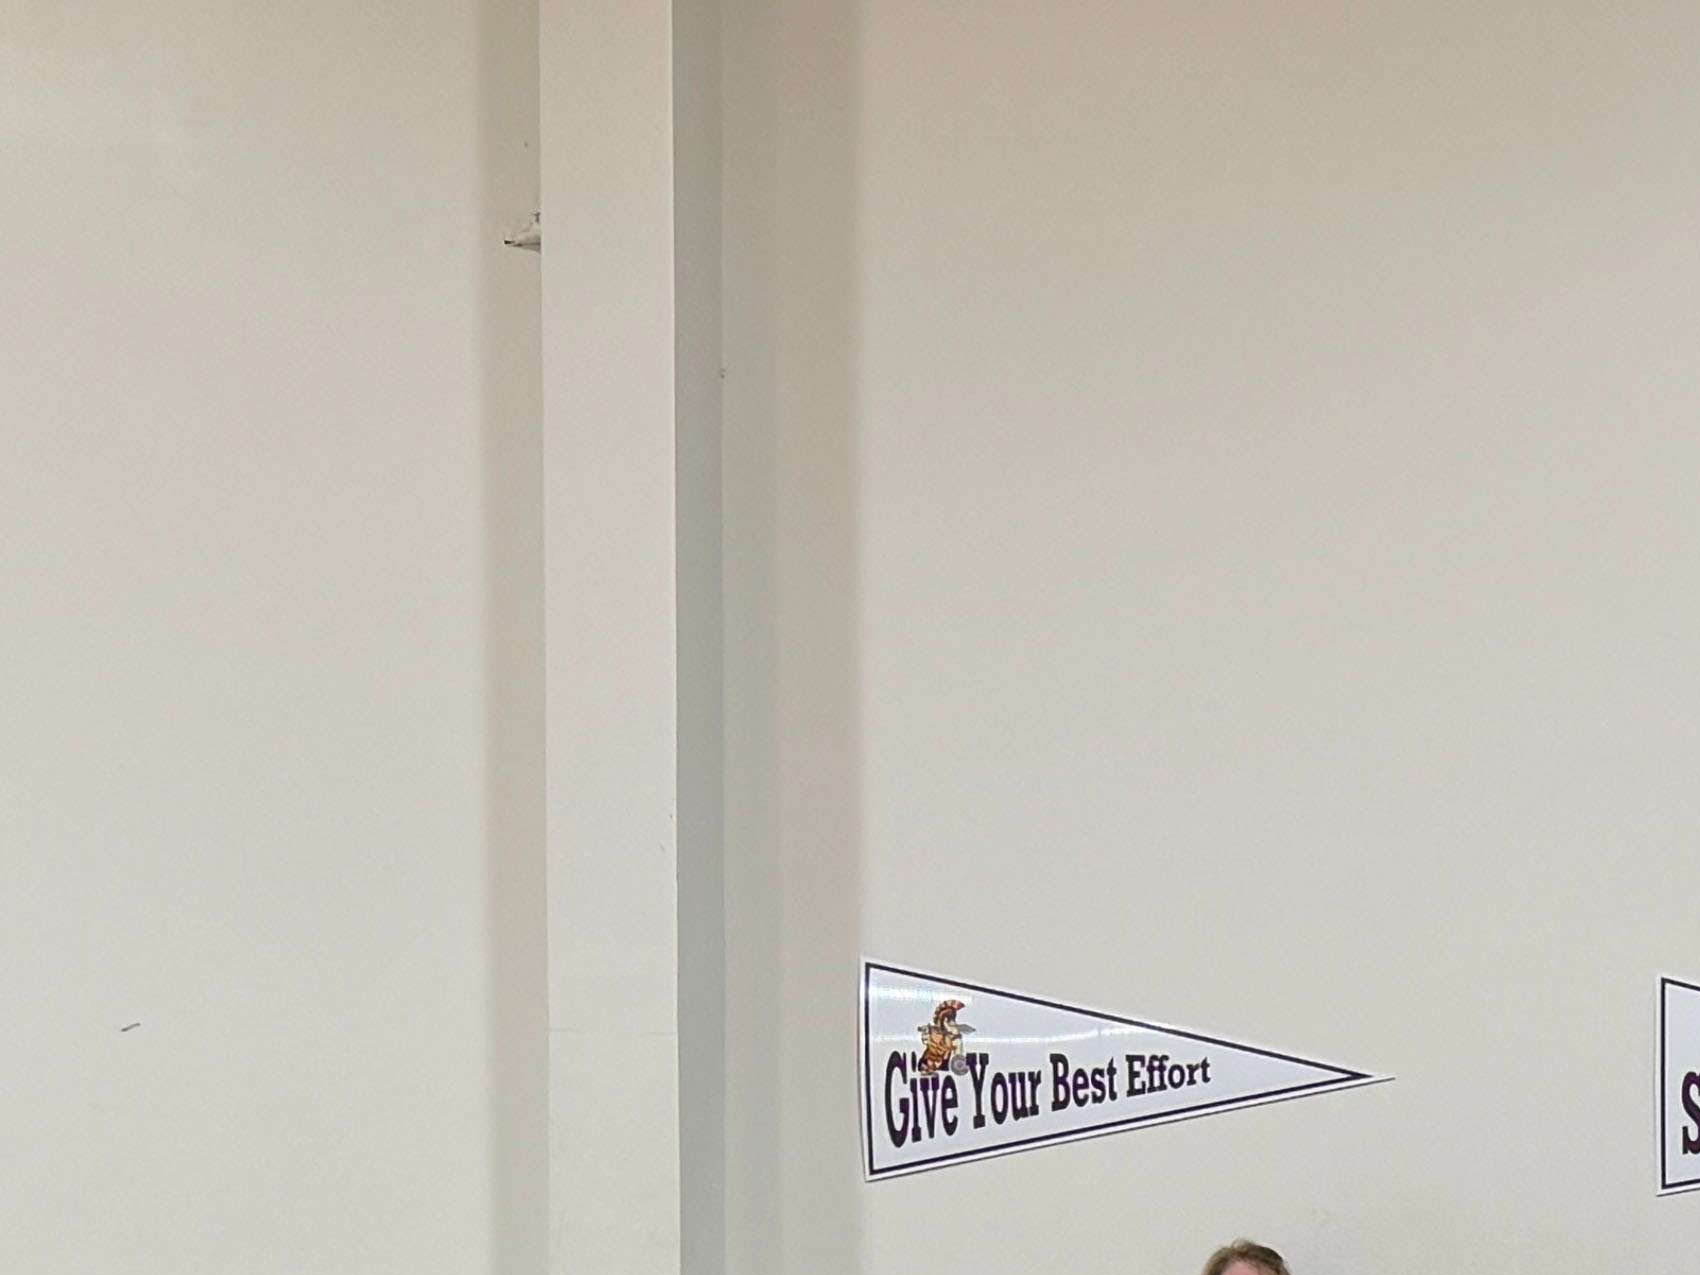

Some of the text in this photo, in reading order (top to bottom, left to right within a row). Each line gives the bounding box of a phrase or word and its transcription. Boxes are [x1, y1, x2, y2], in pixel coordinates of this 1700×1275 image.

[885, 1050, 1212, 1148] Give Your Best Effort
